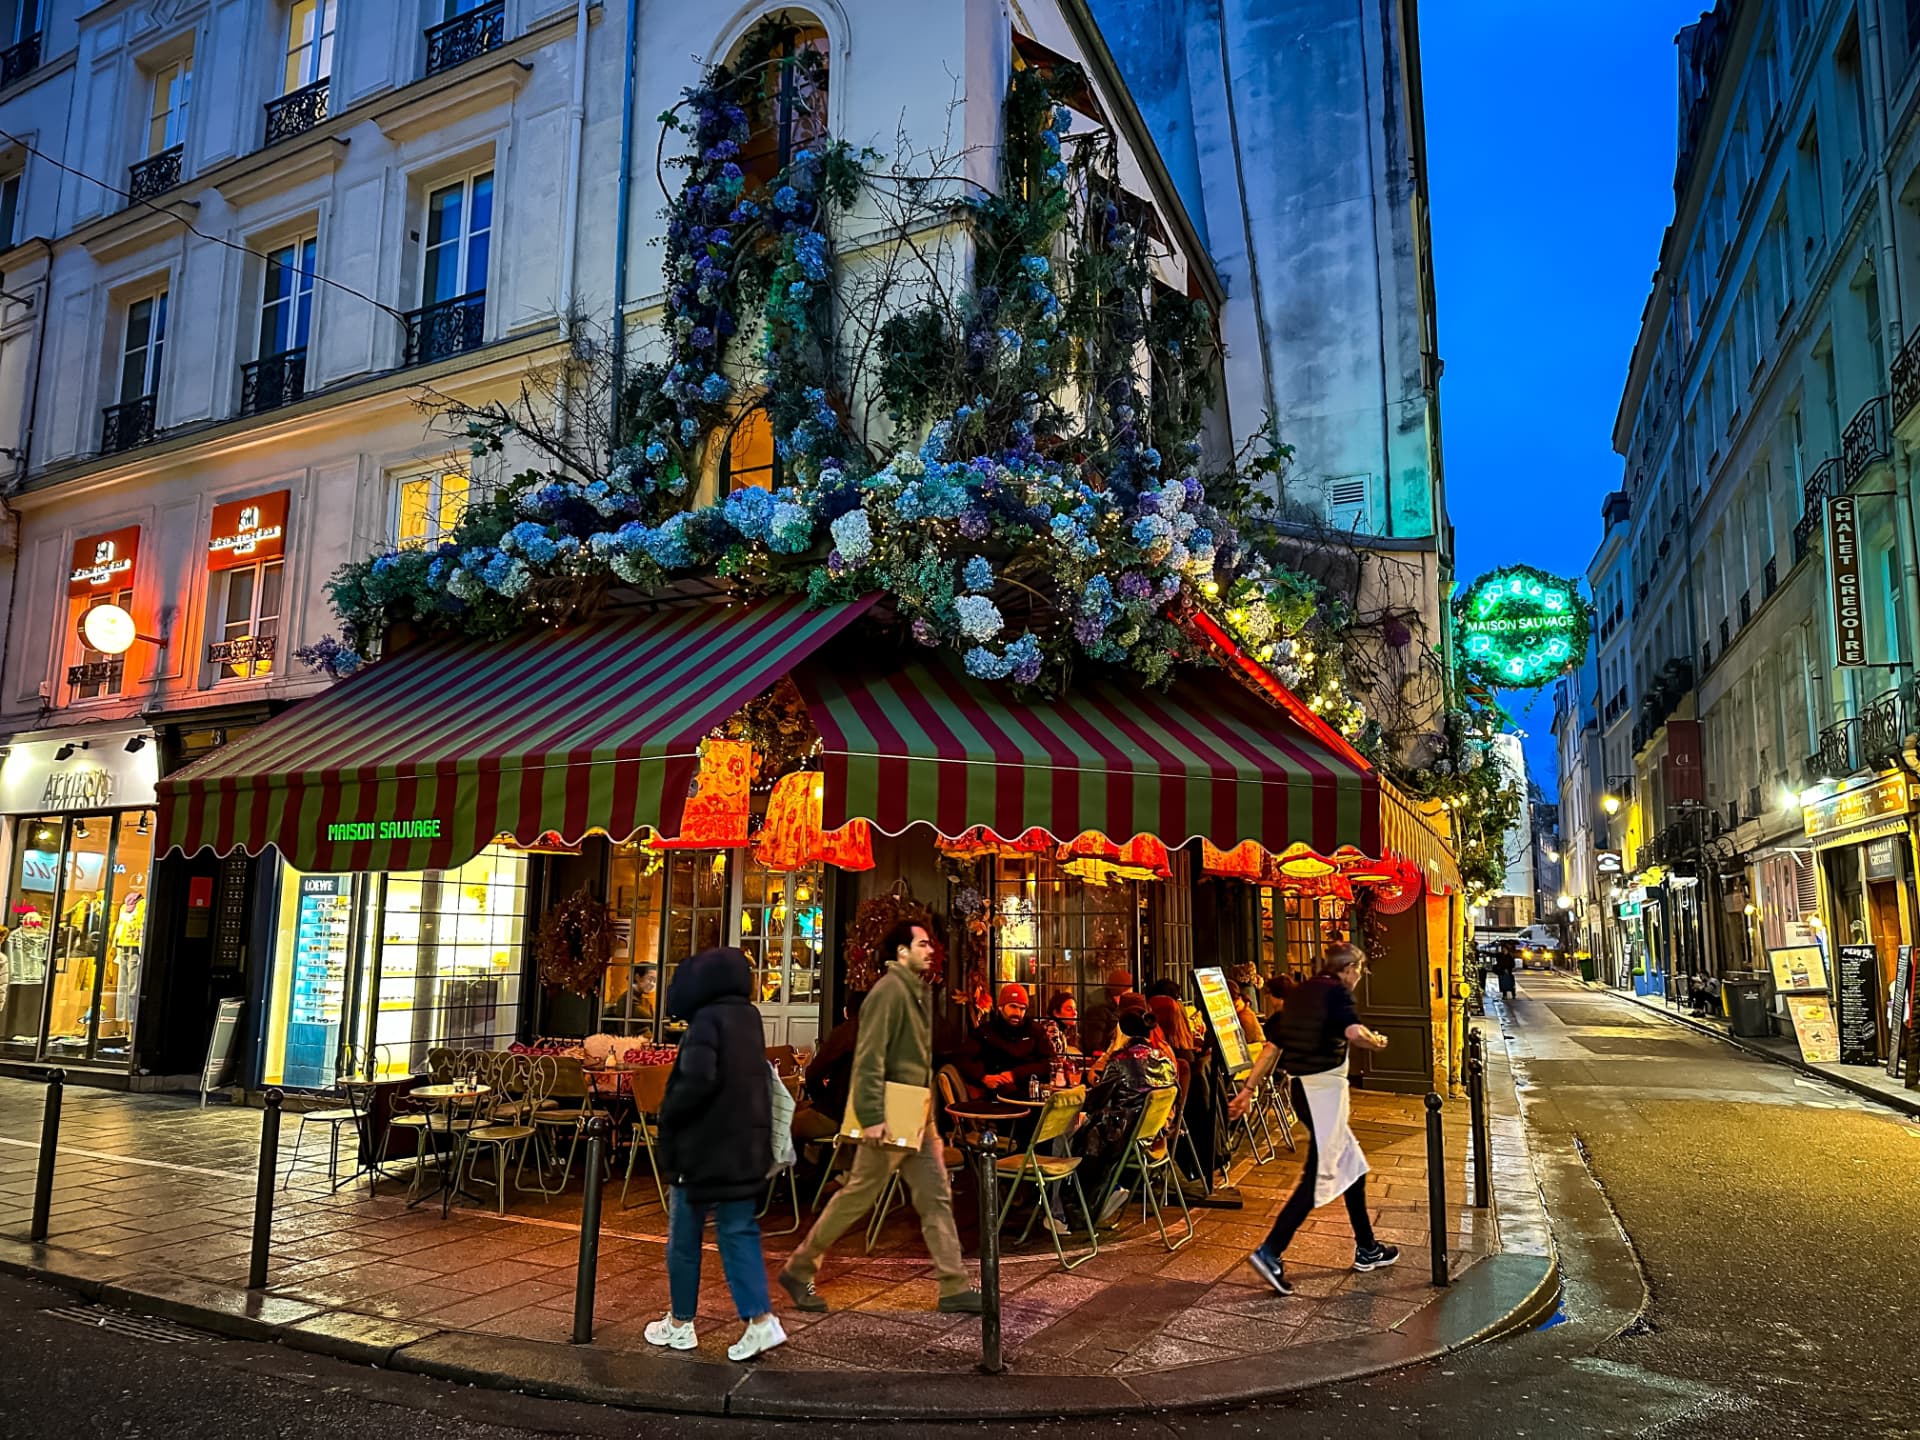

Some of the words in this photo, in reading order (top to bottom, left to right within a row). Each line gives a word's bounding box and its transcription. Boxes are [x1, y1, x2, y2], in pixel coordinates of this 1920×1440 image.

[1836, 501, 1852, 565] CHALET
[1467, 620, 1517, 631] MAISON
[1518, 615, 1575, 629] SAUVAGE
[1839, 574, 1860, 661] GREGOIRE
[328, 823, 375, 840] MAISON
[380, 820, 440, 838] SAUVAGE
[304, 879, 334, 892] LOEWE
